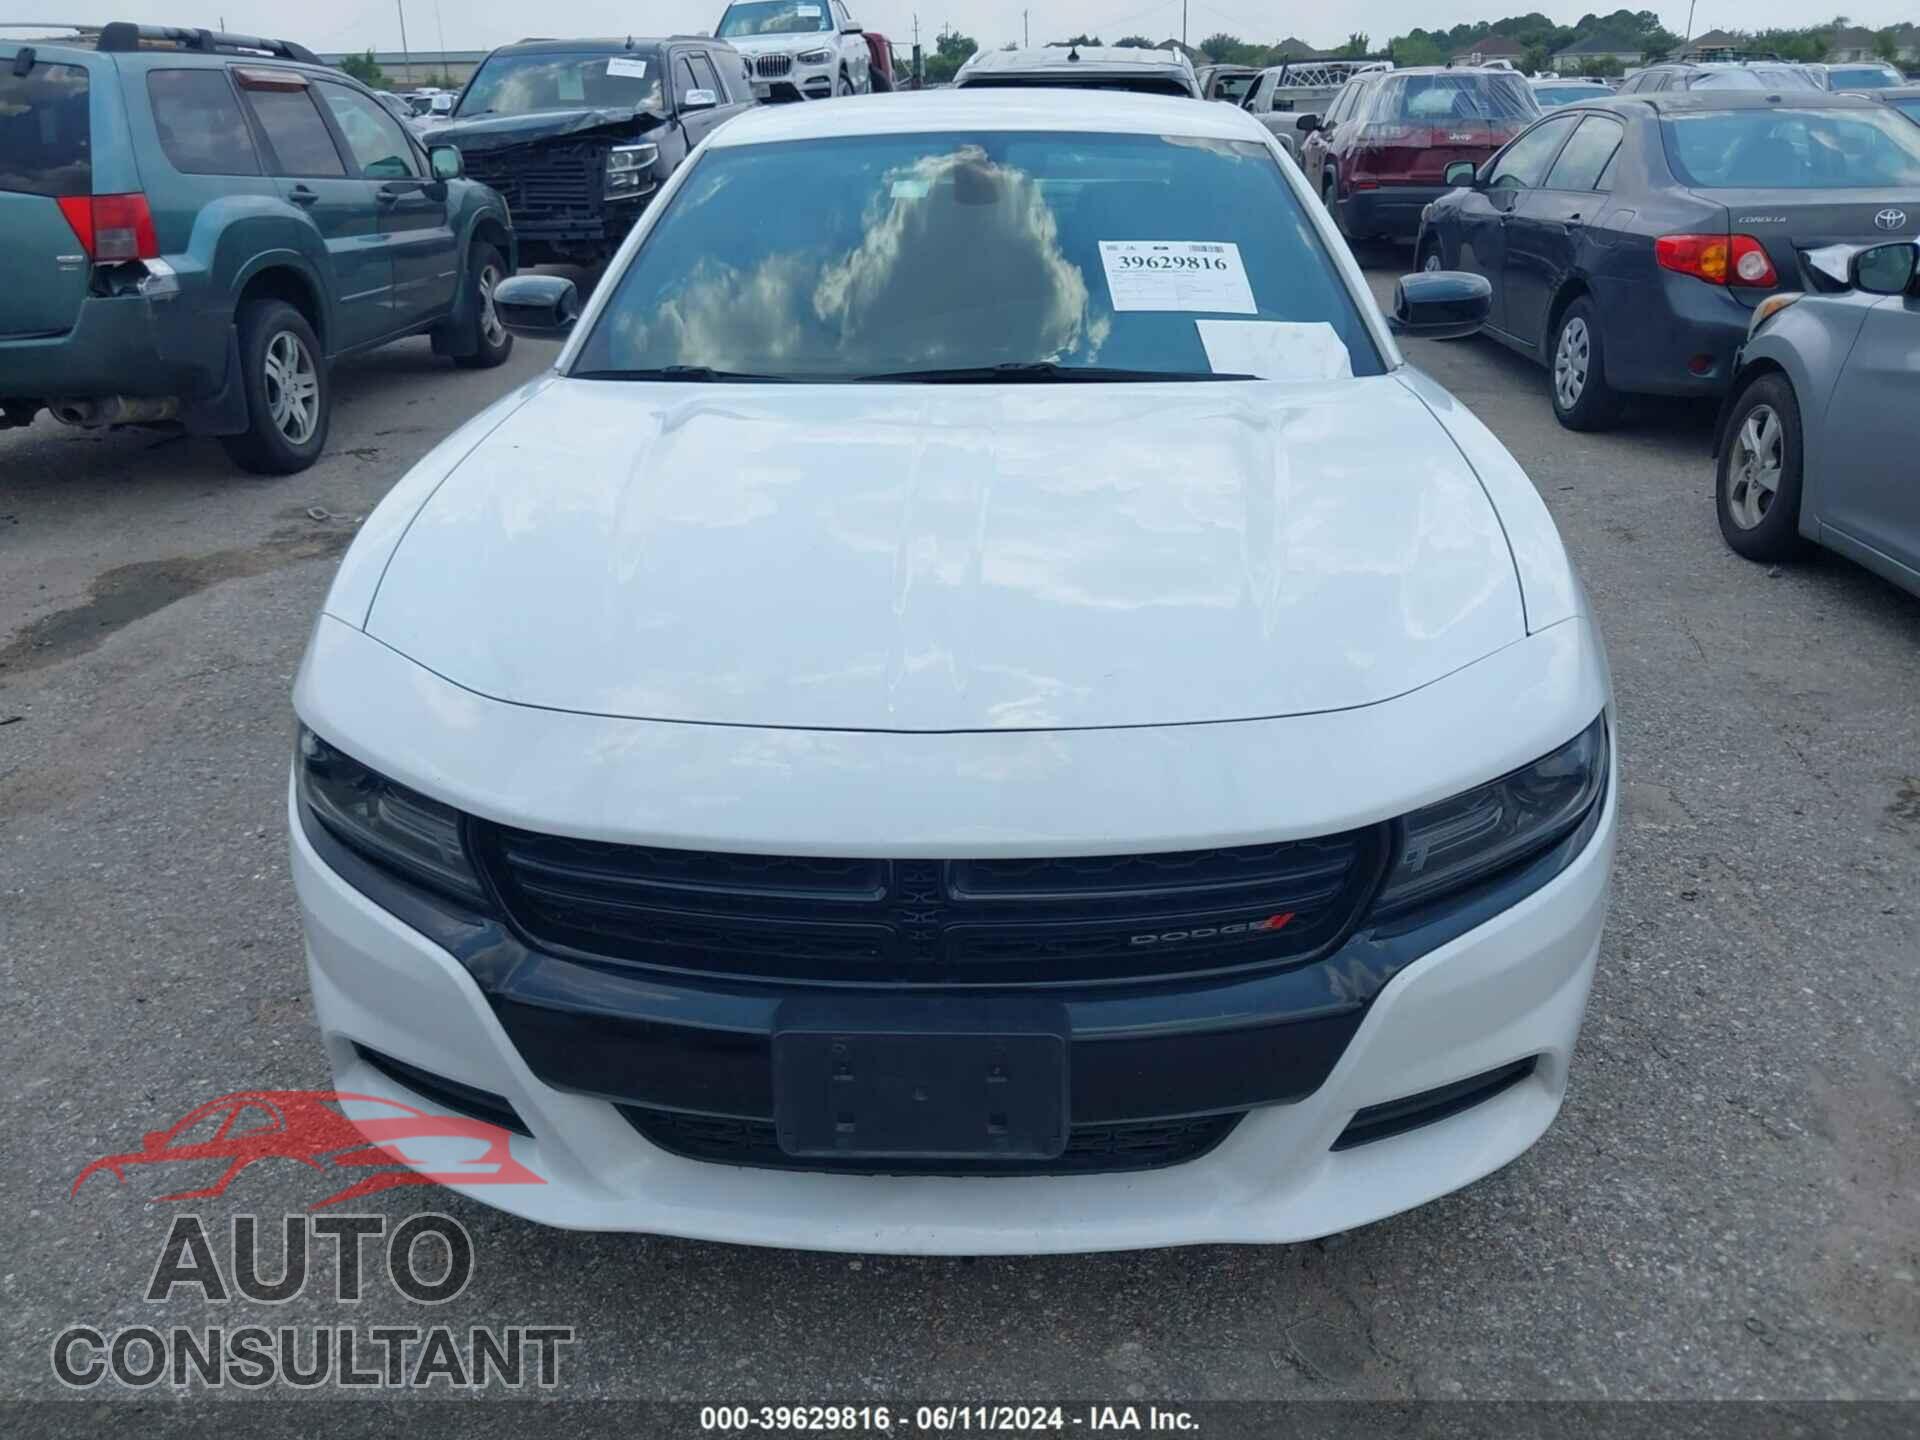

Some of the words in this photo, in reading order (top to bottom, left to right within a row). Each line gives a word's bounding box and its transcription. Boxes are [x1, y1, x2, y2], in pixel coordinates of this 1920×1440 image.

[1738, 216, 1787, 224] COROLLA
[1118, 255, 1227, 271] 39629816
[1130, 920, 1274, 945] DODGE
